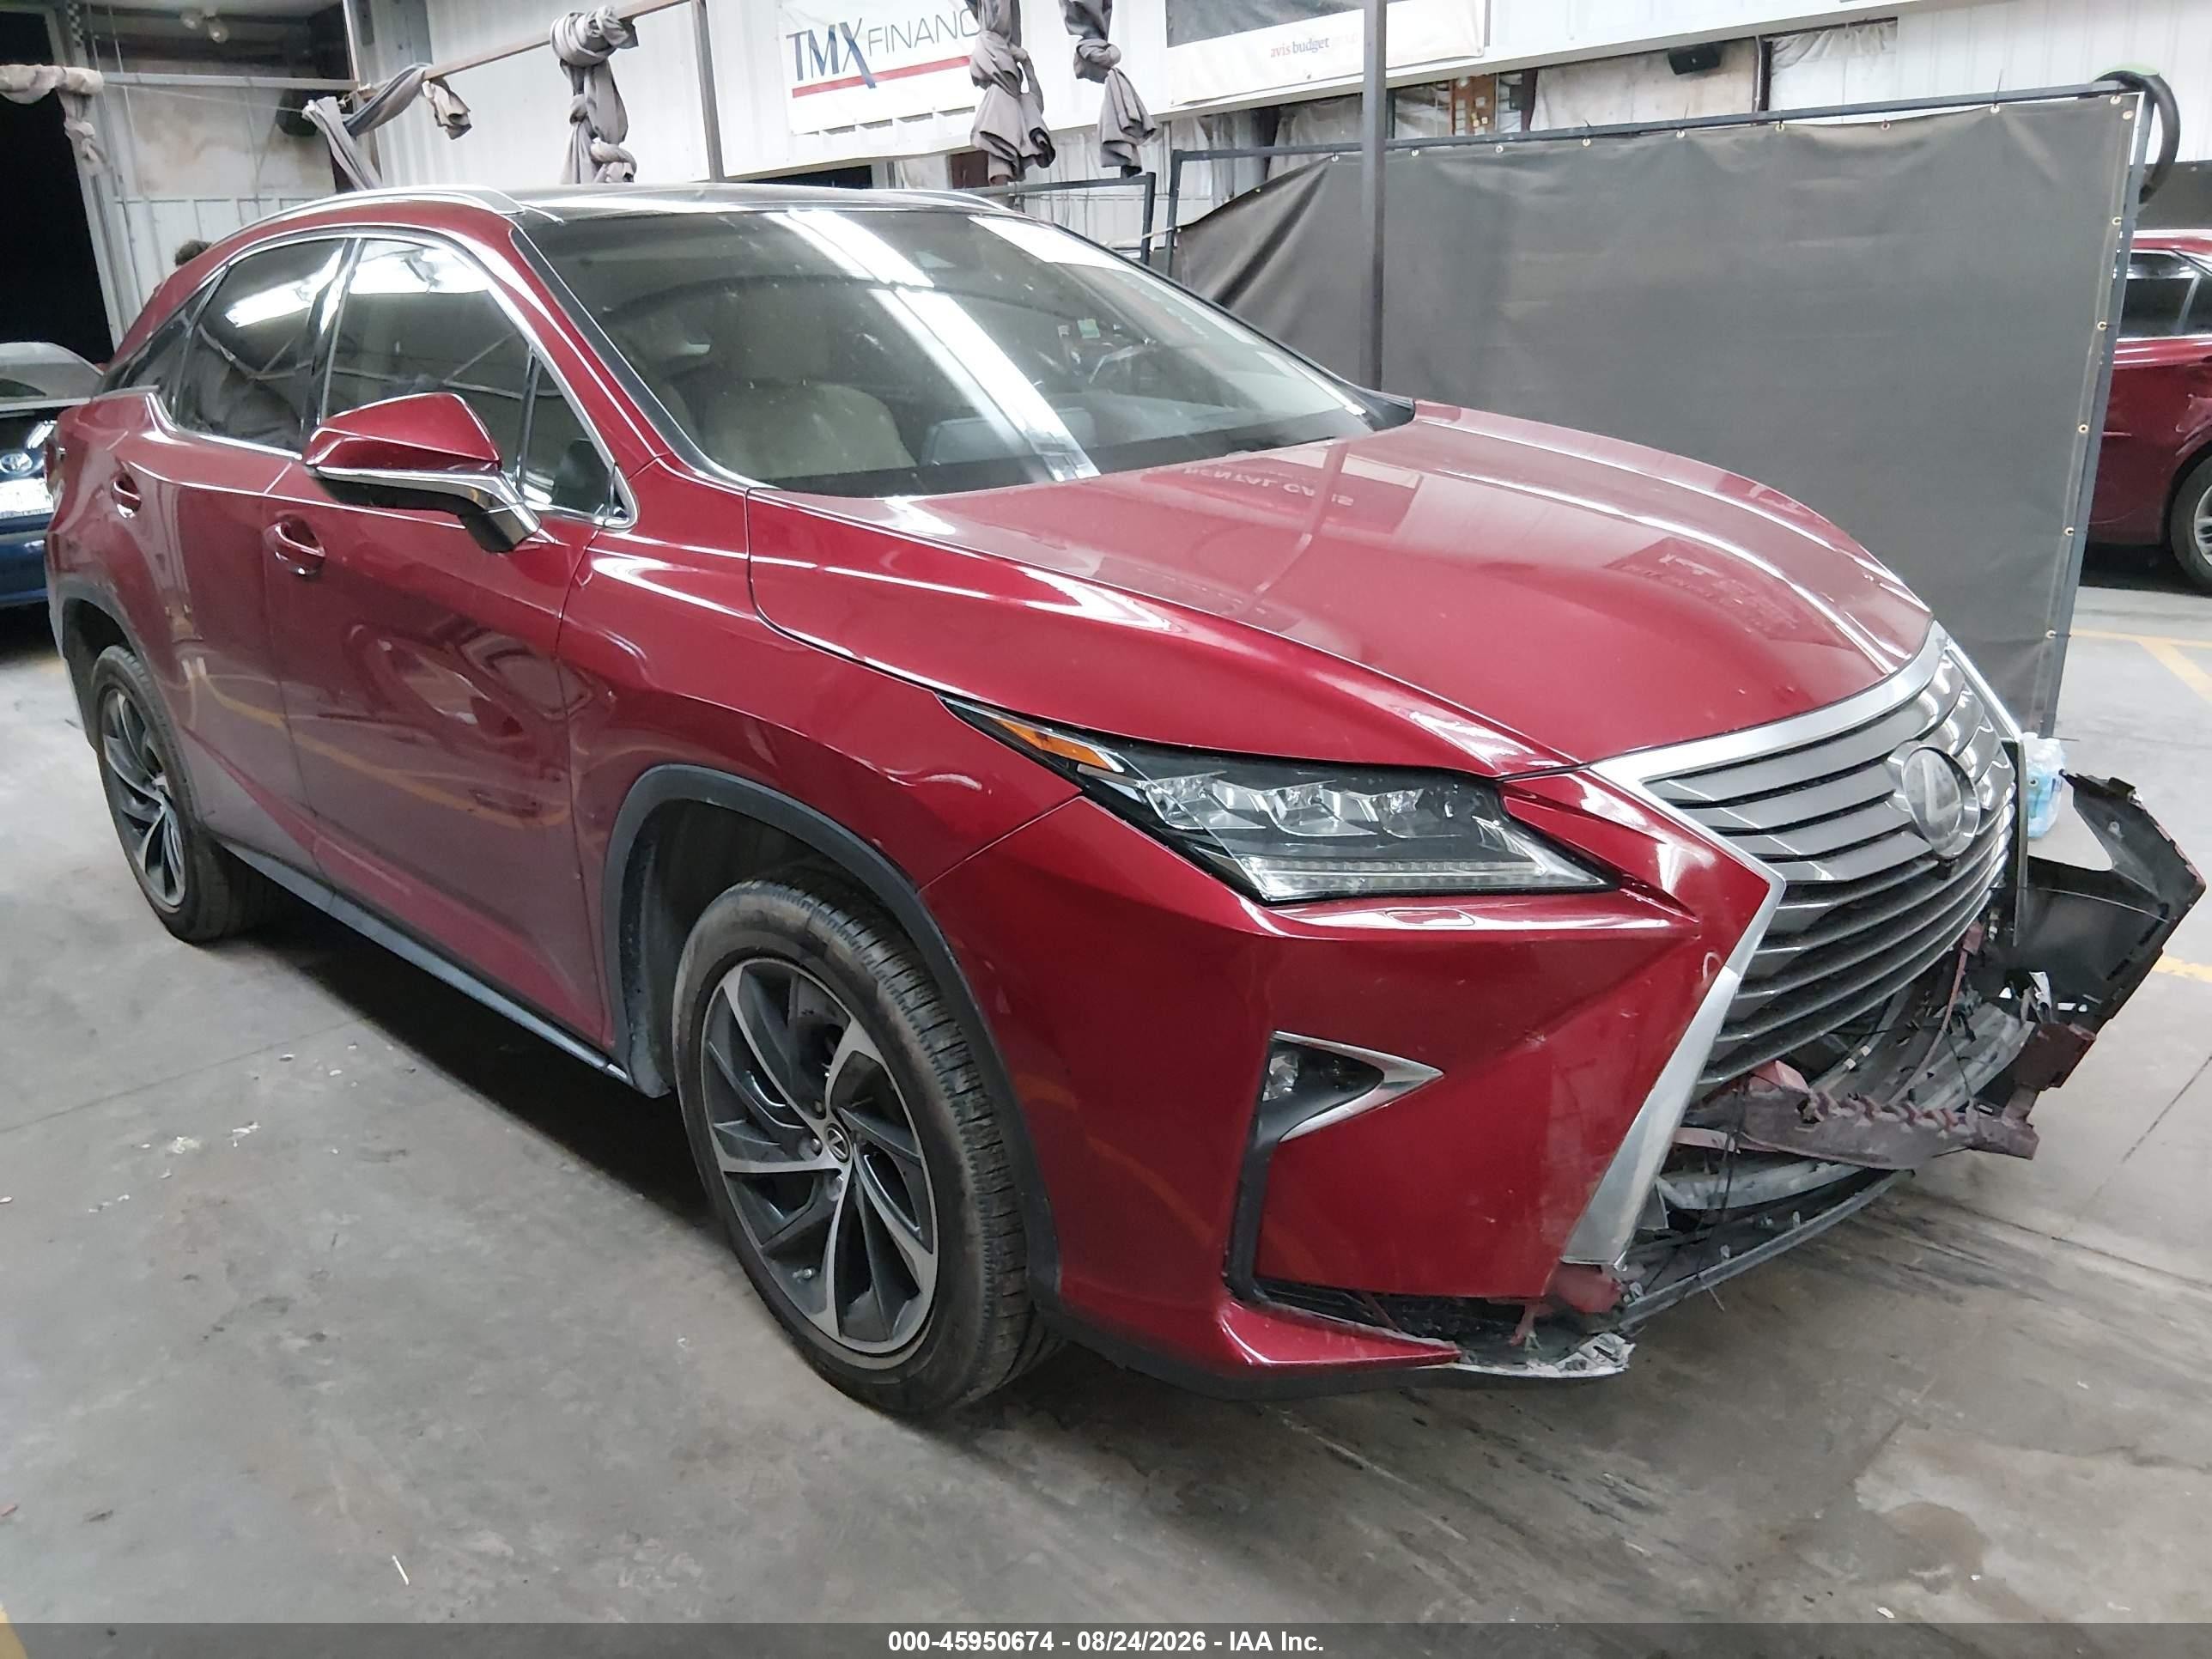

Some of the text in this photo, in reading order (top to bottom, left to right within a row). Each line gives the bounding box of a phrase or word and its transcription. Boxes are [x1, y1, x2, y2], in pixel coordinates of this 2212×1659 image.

[786, 8, 981, 88] TMX FINANC
[1270, 43, 1291, 58] avis
[1291, 37, 1330, 54] budget
